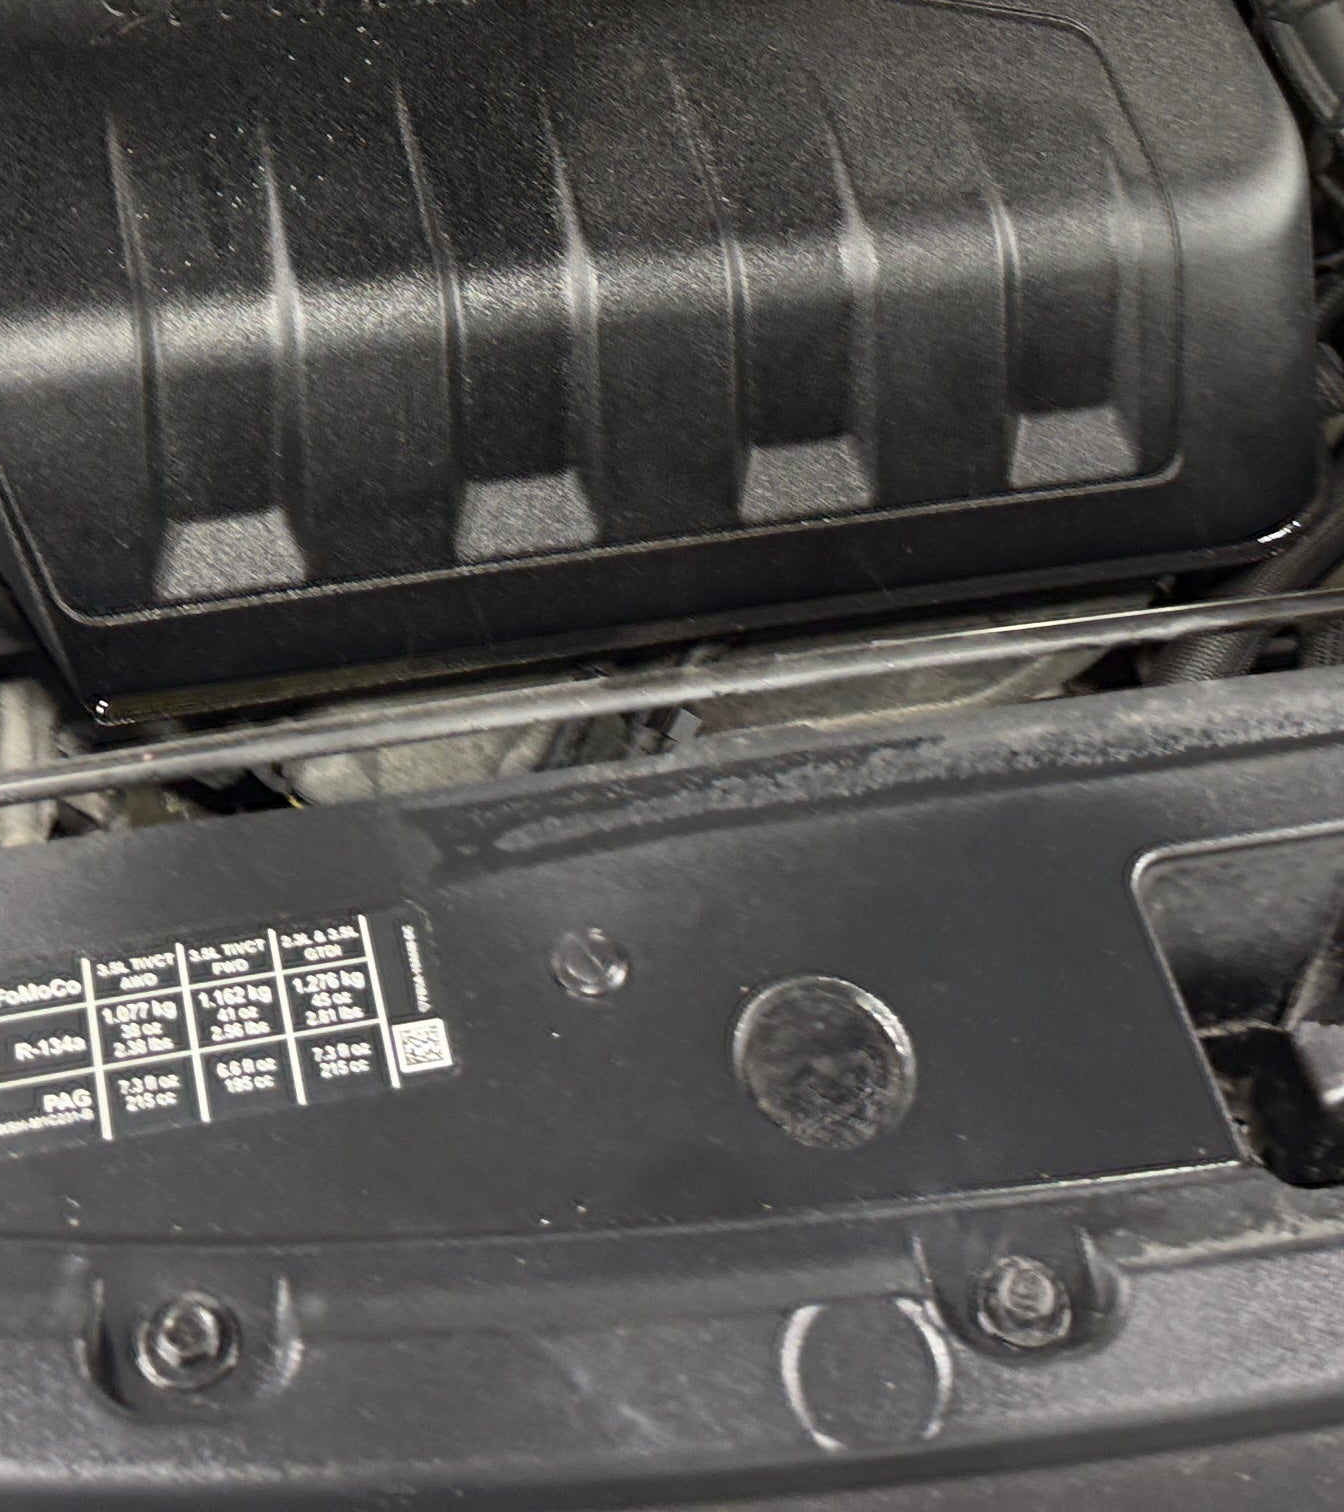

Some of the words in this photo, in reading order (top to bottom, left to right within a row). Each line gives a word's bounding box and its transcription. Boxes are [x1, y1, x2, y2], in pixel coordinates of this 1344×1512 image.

[292, 972, 340, 994] 1.276
[339, 970, 366, 989] kg
[198, 986, 247, 1009] 1.162
[246, 984, 273, 1004] kg
[101, 1001, 150, 1025] 1.077
[151, 999, 178, 1024] kg
[14, 1035, 87, 1061] R-134a
[43, 1088, 93, 1113] PAG
